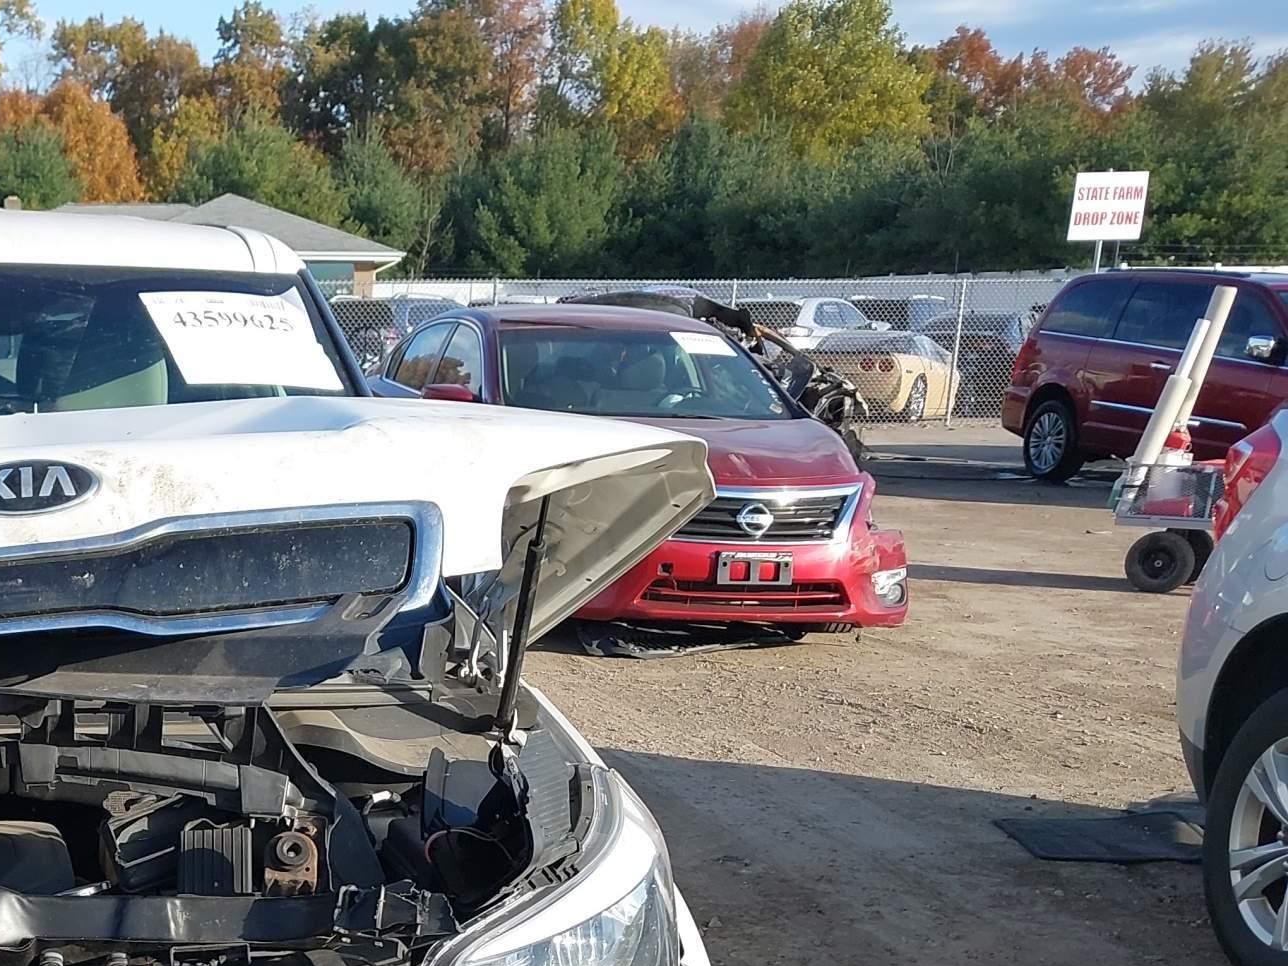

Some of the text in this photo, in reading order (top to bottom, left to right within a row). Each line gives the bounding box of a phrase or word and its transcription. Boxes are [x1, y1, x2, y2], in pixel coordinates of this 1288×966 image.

[1078, 186, 1143, 200] STATE FARM
[1073, 211, 1140, 226] DROP ZONE
[172, 310, 294, 331] 43599625
